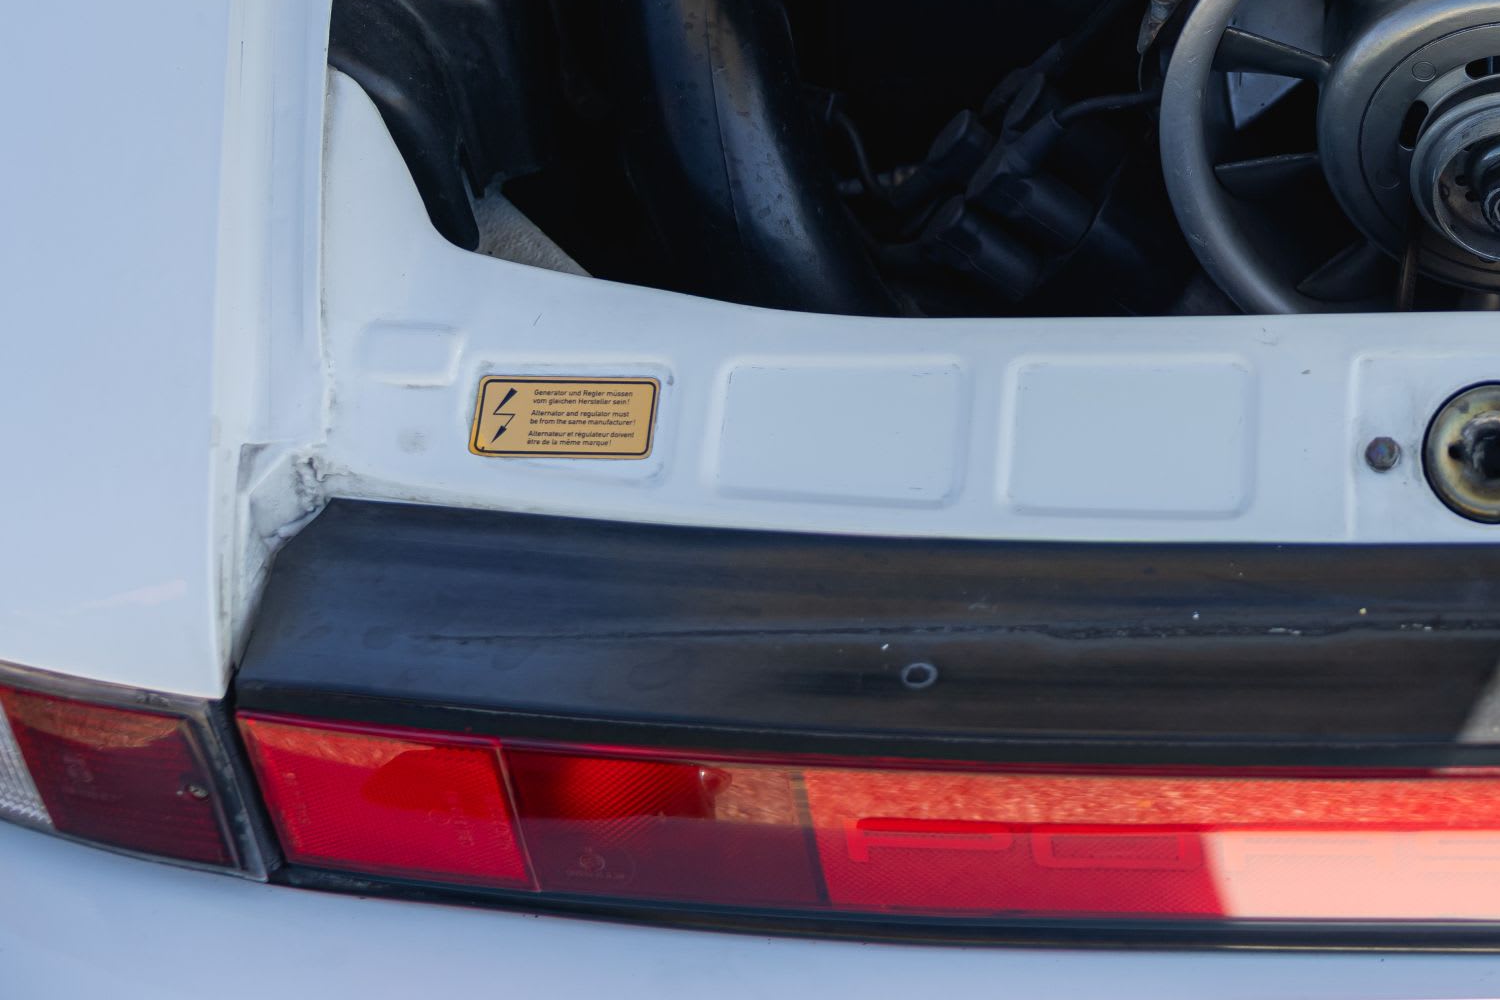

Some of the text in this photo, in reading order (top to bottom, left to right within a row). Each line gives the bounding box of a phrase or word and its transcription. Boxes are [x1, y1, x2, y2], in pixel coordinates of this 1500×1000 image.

[568, 389, 582, 397] und
[583, 389, 605, 398] Regler
[580, 410, 610, 418] regulator
[528, 430, 566, 438] Alternateur
[610, 430, 636, 438] doivent
